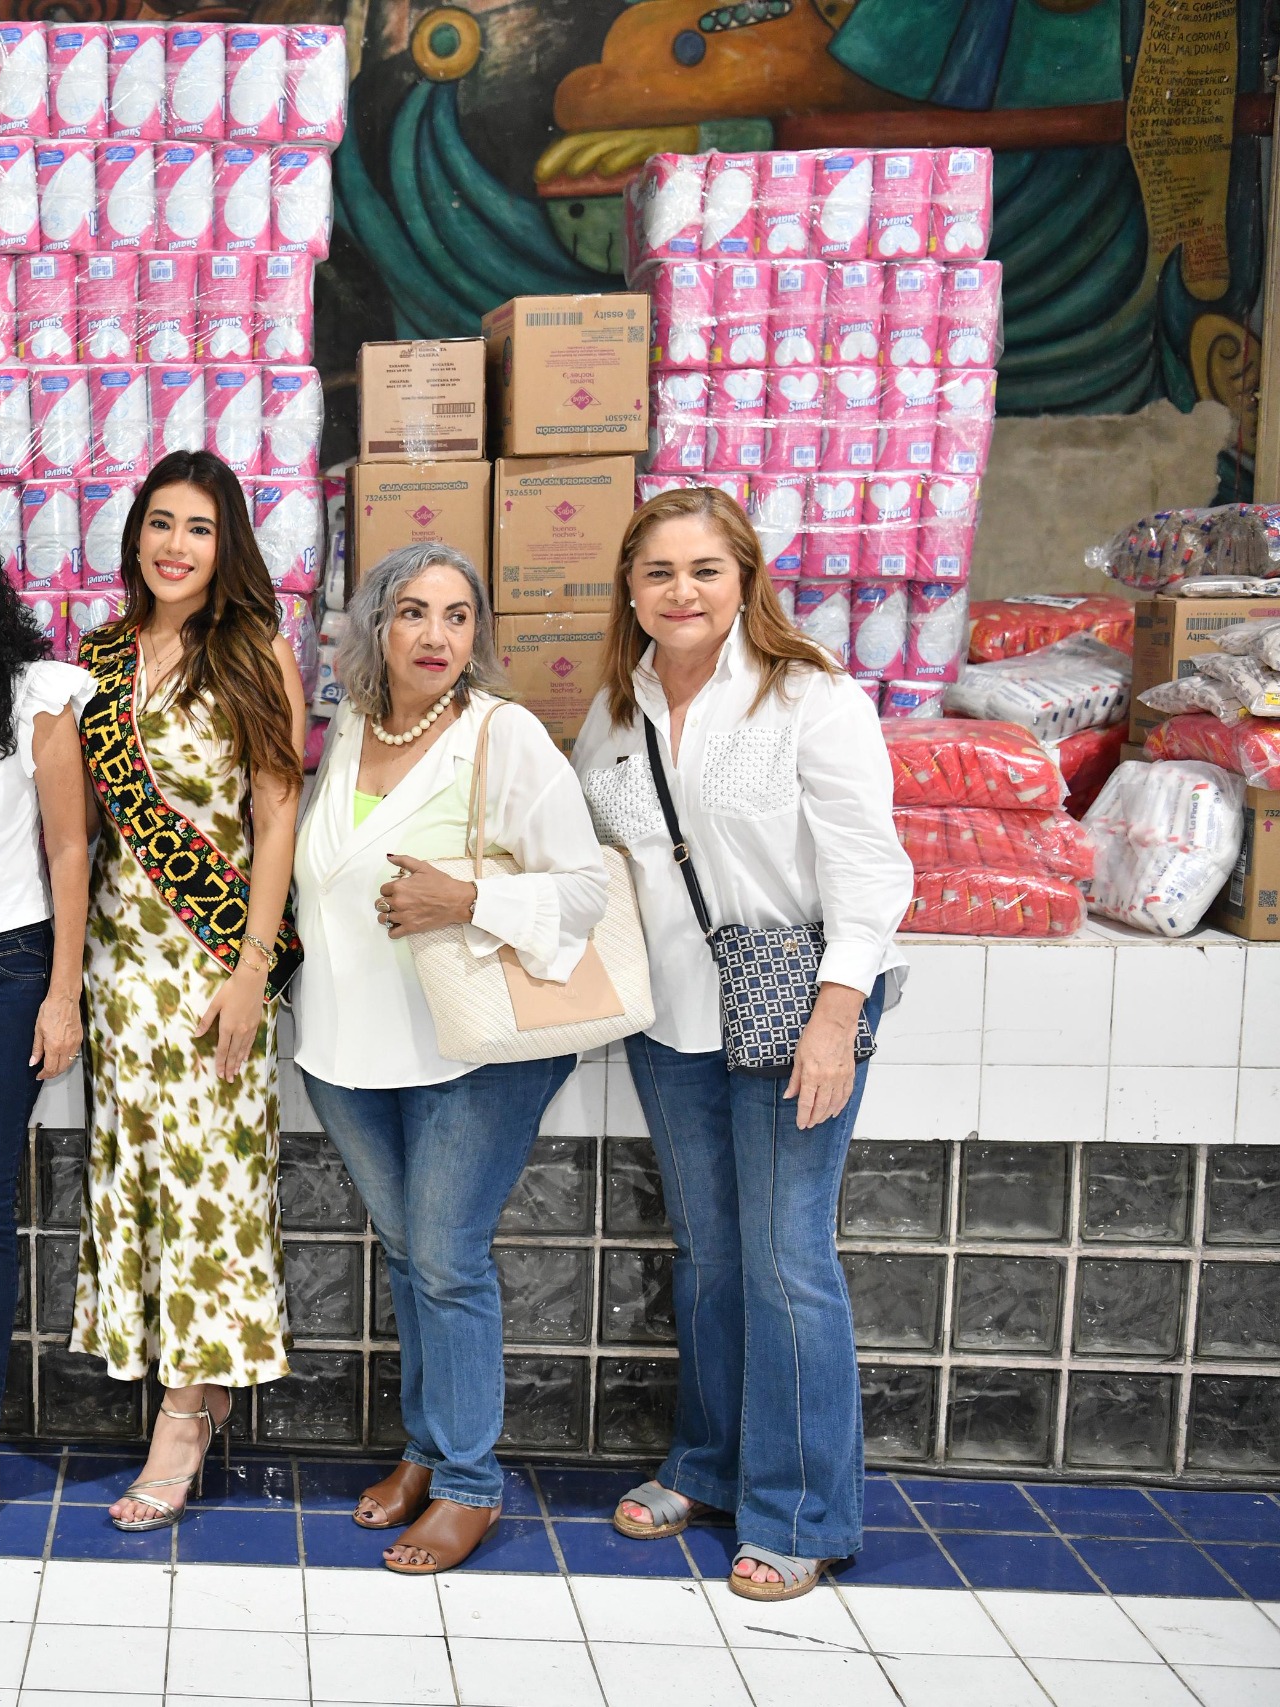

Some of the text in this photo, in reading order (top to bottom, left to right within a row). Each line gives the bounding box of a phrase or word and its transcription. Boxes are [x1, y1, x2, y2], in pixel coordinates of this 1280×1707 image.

[1147, 28, 1176, 41] JORGE
[1186, 31, 1221, 42] CORONA
[1224, 30, 1229, 39] Y
[0, 118, 29, 133] Suavel
[59, 124, 87, 139] Suavel
[174, 122, 204, 137] Suavel
[229, 124, 259, 139] Suavel
[724, 157, 755, 170] Suavel
[767, 213, 801, 227] Suavel
[878, 214, 914, 230] Suavel
[111, 235, 140, 249] Suavel
[168, 238, 198, 251] Suavel
[226, 238, 257, 251] Suavel
[822, 241, 851, 255] Suavel
[208, 315, 242, 330] Suavel
[593, 310, 624, 321] essity
[29, 316, 62, 331] Suavel
[87, 316, 121, 333] Suavel
[839, 321, 874, 336] Suavel
[729, 323, 761, 339] Suavel
[773, 325, 807, 341] Suavel
[890, 326, 924, 342] Suavel
[733, 397, 763, 411] Suavel
[846, 395, 877, 410] Suavel
[904, 394, 936, 408] Suavel
[536, 425, 627, 436] CAJA CON PROMOCIÓN
[44, 465, 74, 479] Suavel
[228, 461, 248, 473] Sua
[271, 464, 300, 477] Suavel
[379, 481, 468, 492] CAJA CON PROMOCIÓN
[520, 475, 611, 486] CAJA CON PROMOCIÓN
[365, 494, 401, 502] 73265301
[416, 511, 432, 520] Saba
[557, 507, 574, 516] Saba
[821, 507, 855, 521] Suavel
[877, 506, 911, 521] Suavel
[87, 573, 114, 586] Suavel
[517, 634, 539, 642] CAJA
[539, 634, 558, 642] CON
[554, 662, 571, 672] Saba
[855, 668, 885, 679] Suavel
[916, 665, 945, 676] Suavel
[84, 699, 200, 883] TABASCO
[1264, 809, 1280, 818] 732
